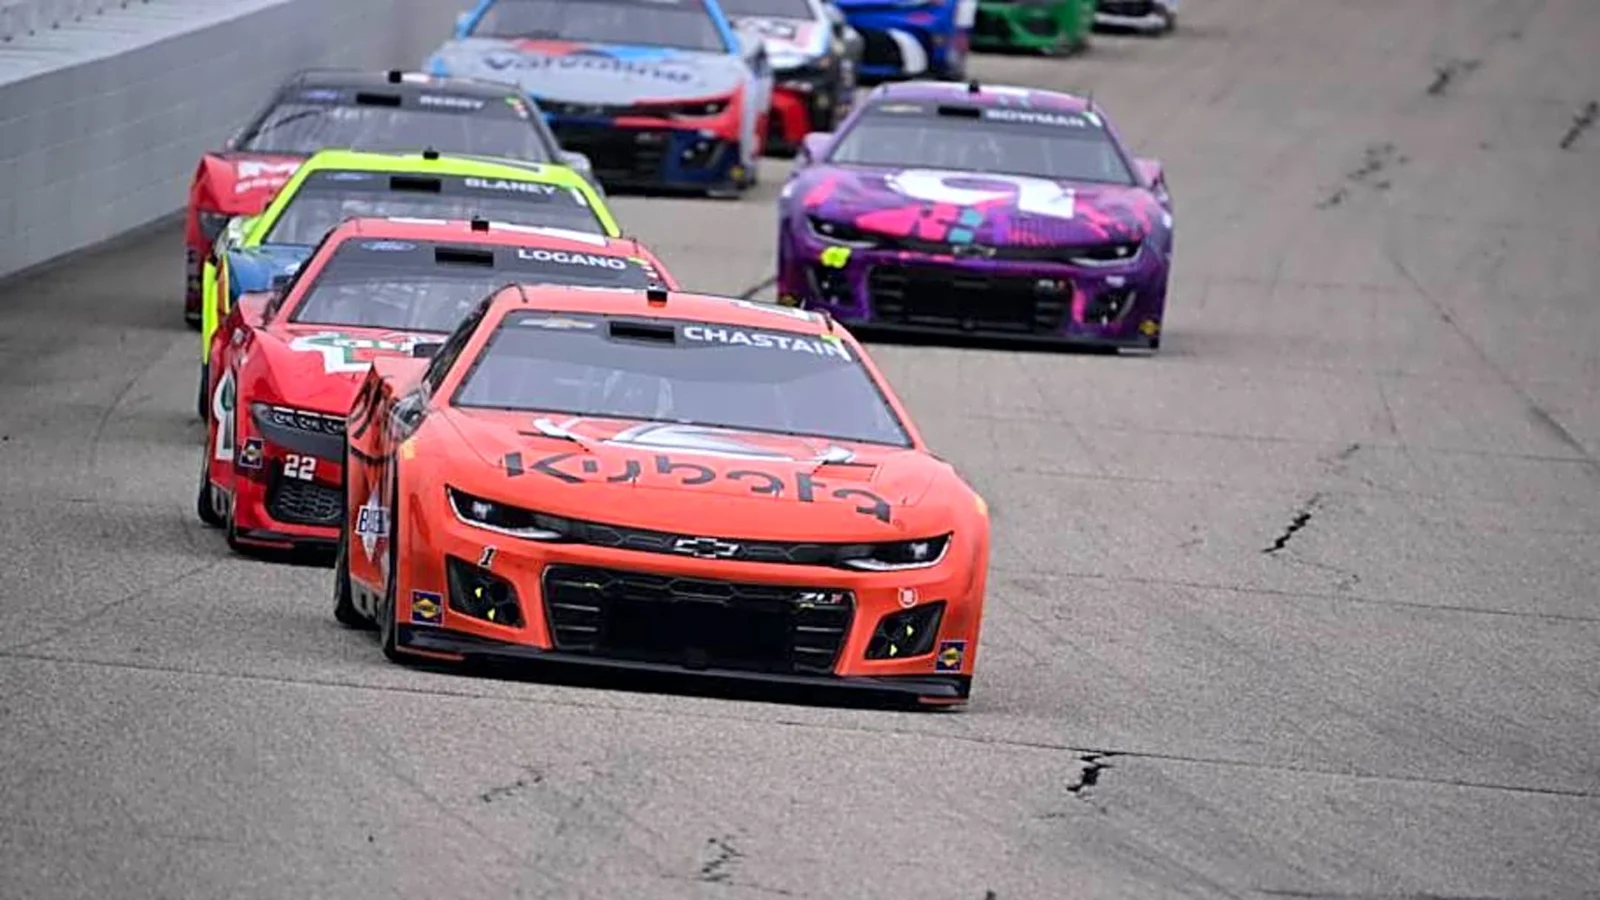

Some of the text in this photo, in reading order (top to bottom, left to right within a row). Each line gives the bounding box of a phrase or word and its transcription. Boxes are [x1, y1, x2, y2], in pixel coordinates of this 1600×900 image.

[985, 107, 1086, 128] BOWMAN
[465, 177, 558, 196] BLANEY
[518, 247, 628, 271] LOGANO
[683, 325, 849, 362] CHASTAIN
[284, 454, 316, 480] 22
[504, 450, 892, 523] Kubota
[478, 545, 496, 569] 1
